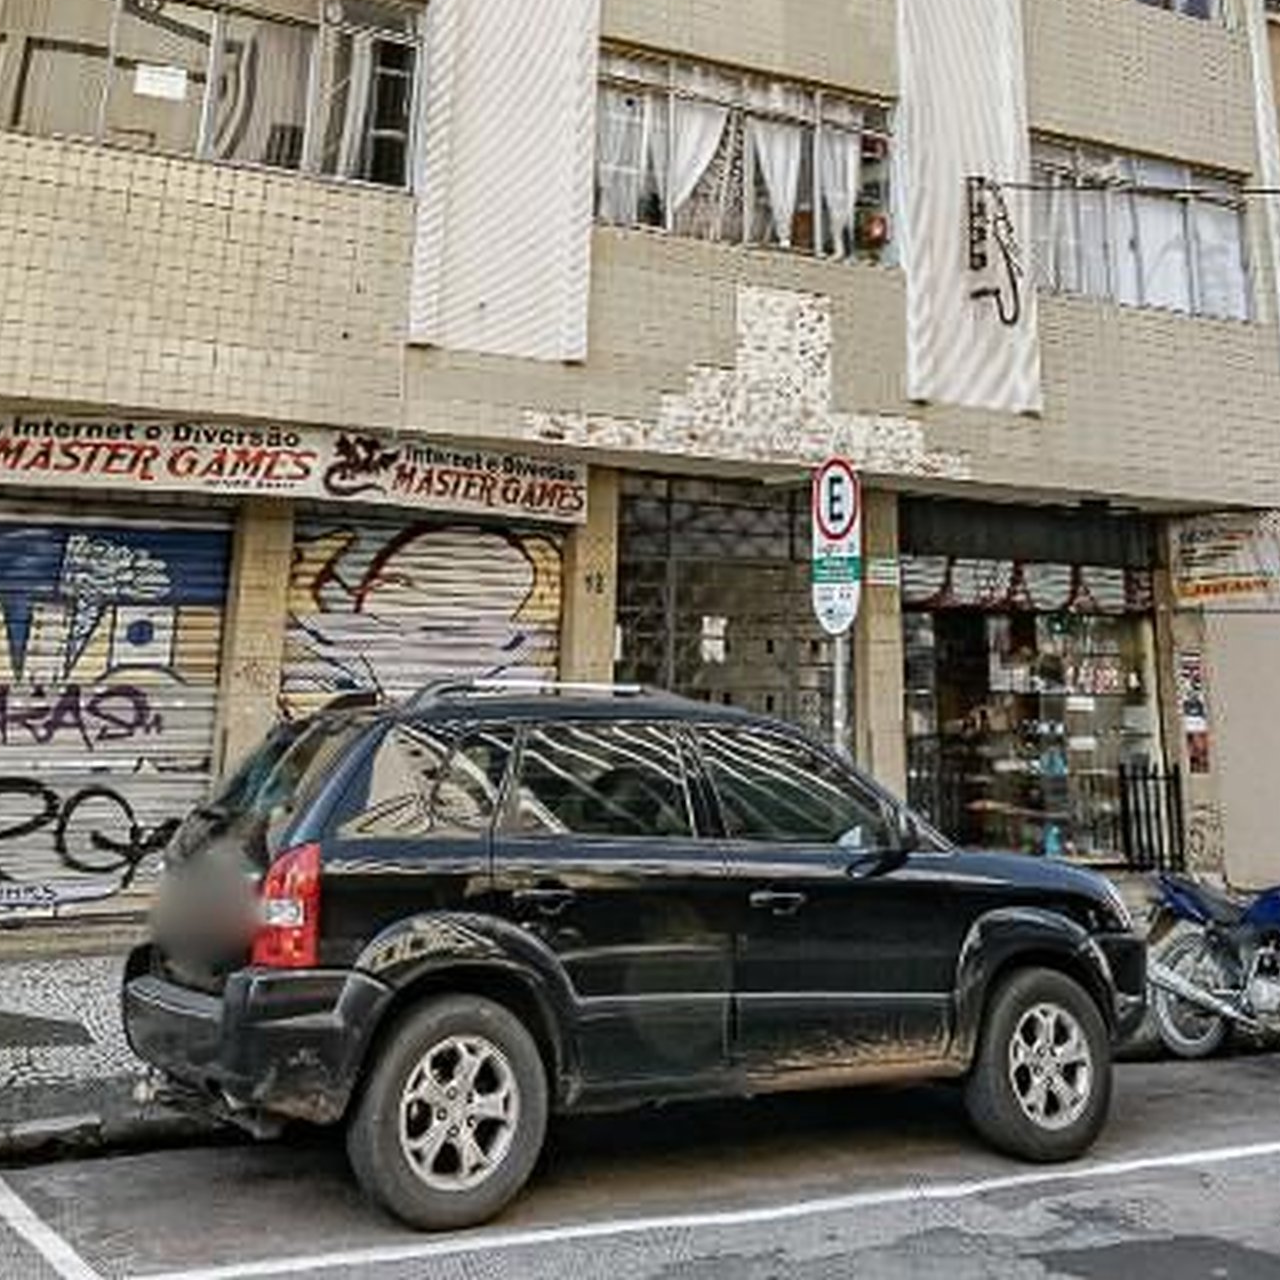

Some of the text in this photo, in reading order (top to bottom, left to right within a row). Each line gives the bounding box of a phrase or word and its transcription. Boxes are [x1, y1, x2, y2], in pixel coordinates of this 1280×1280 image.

[13, 416, 134, 441] Internet
[172, 421, 300, 448] Diversão
[166, 444, 319, 481] GAMES
[391, 463, 586, 512] MASTER GAMES
[828, 476, 845, 522] E
